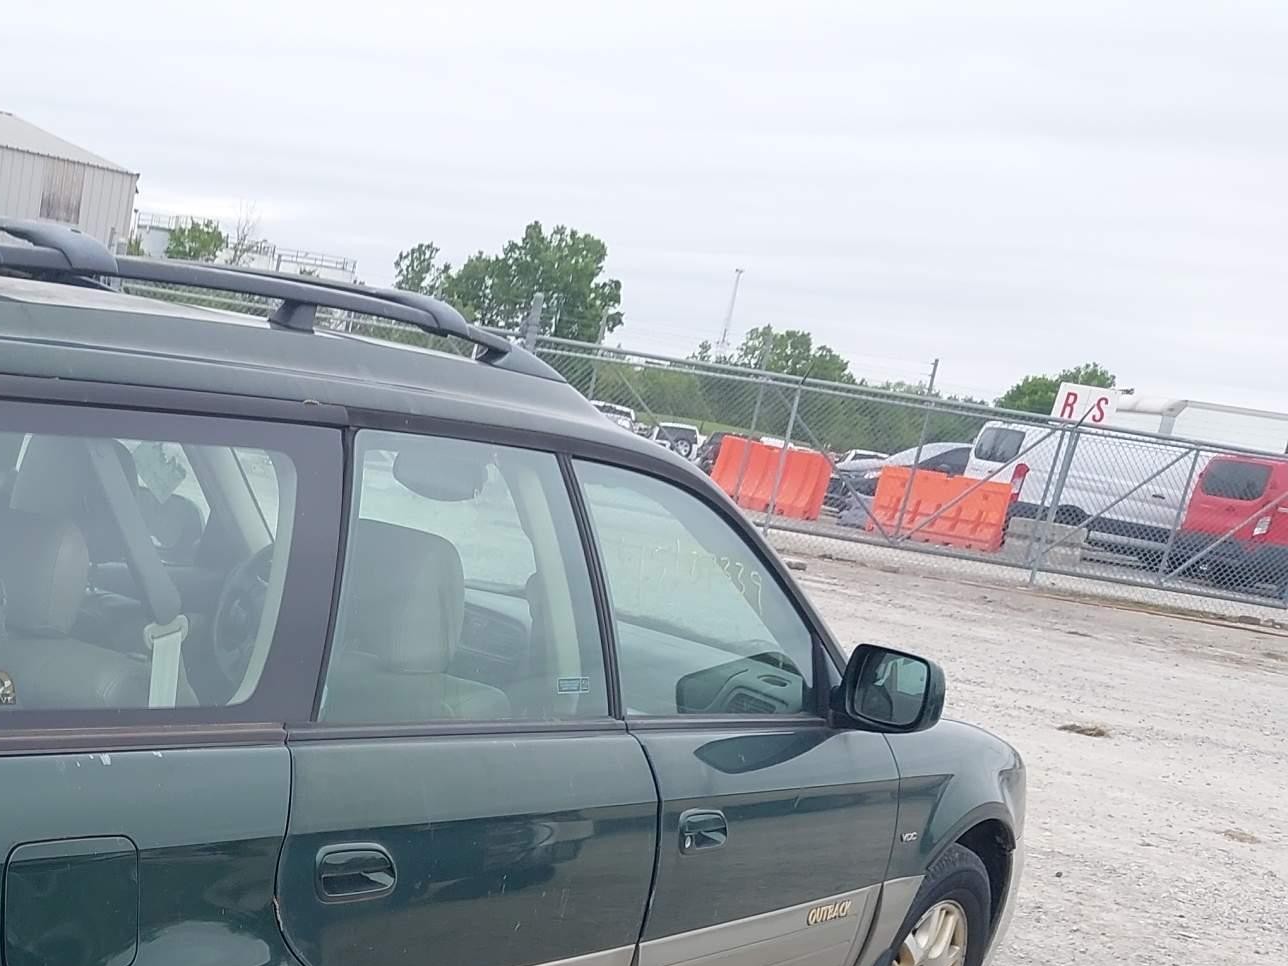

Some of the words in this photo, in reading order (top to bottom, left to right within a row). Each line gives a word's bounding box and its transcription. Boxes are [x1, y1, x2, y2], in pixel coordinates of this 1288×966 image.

[1060, 391, 1079, 419] R
[1092, 396, 1109, 423] S
[807, 900, 852, 926] OUTBACK
